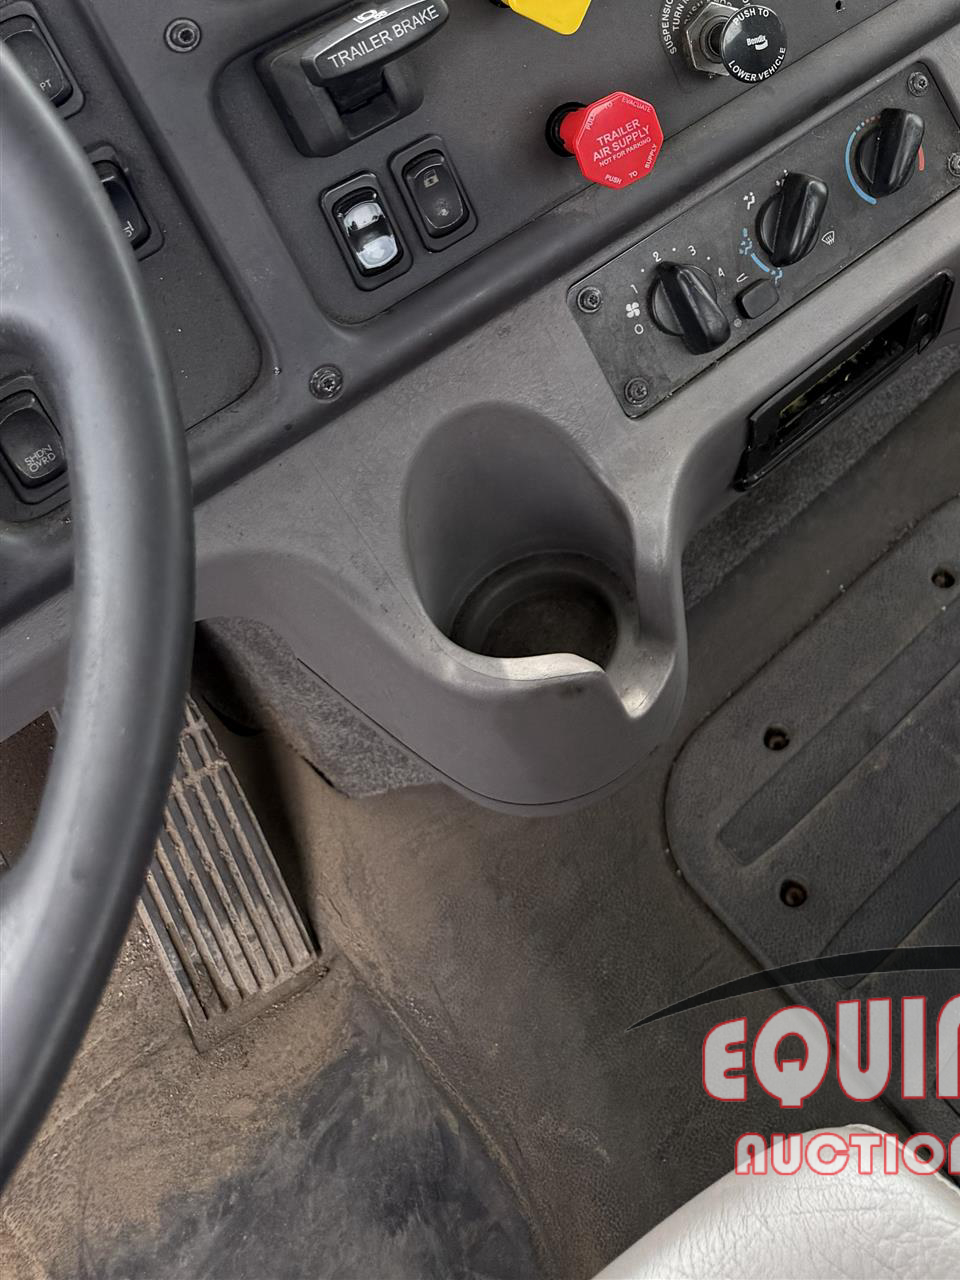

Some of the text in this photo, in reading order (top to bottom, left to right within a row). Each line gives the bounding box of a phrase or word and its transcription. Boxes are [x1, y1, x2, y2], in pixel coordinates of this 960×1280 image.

[672, 2, 685, 32] TURN
[732, 7, 770, 26] PUSH TO
[327, 5, 439, 68] TRAILER BRAKE
[728, 47, 786, 81] LOWER VEHICLE
[622, 96, 652, 113] EVACUATE
[593, 125, 650, 162] AIR SUPPLY
[597, 119, 640, 146] TRAILER
[599, 137, 652, 167] NOT FOR PARKING
[604, 144, 657, 184] PUSH TO SUPPLY
[652, 251, 662, 262] 2
[688, 245, 697, 256] 3
[718, 267, 726, 278] 4
[630, 284, 639, 294] 1
[24, 444, 53, 466] SHDN
[29, 452, 56, 473] OVRD
